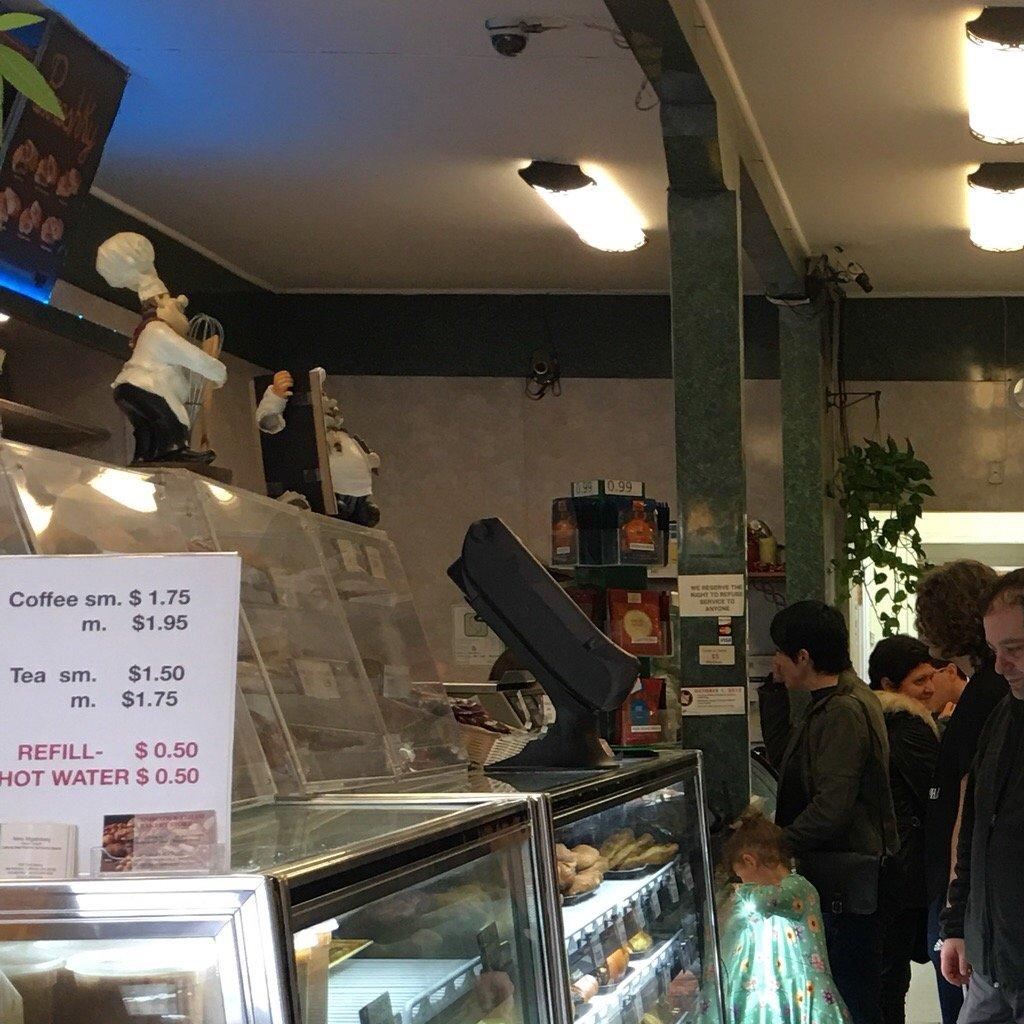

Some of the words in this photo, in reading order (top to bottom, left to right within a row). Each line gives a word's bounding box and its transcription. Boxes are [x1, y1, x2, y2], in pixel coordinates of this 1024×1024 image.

[607, 480, 633, 493] 0.99
[8, 591, 78, 608] Coffee
[85, 594, 122, 607] sm.
[128, 588, 142, 607] $
[148, 589, 191, 606] 1.75
[82, 618, 107, 632] m.
[132, 614, 189, 632] $1.95
[10, 667, 46, 684] Tea
[59, 670, 97, 683] sm.
[128, 664, 185, 683] $1.50
[71, 694, 96, 709] m.
[121, 690, 178, 709] $1.75
[17, 743, 103, 760] REFILL-
[135, 740, 149, 760] $
[154, 741, 199, 759] 0.50
[0, 769, 45, 787] HOT
[51, 768, 129, 787] WATER
[135, 767, 149, 787] $
[155, 767, 199, 785] 0.50
